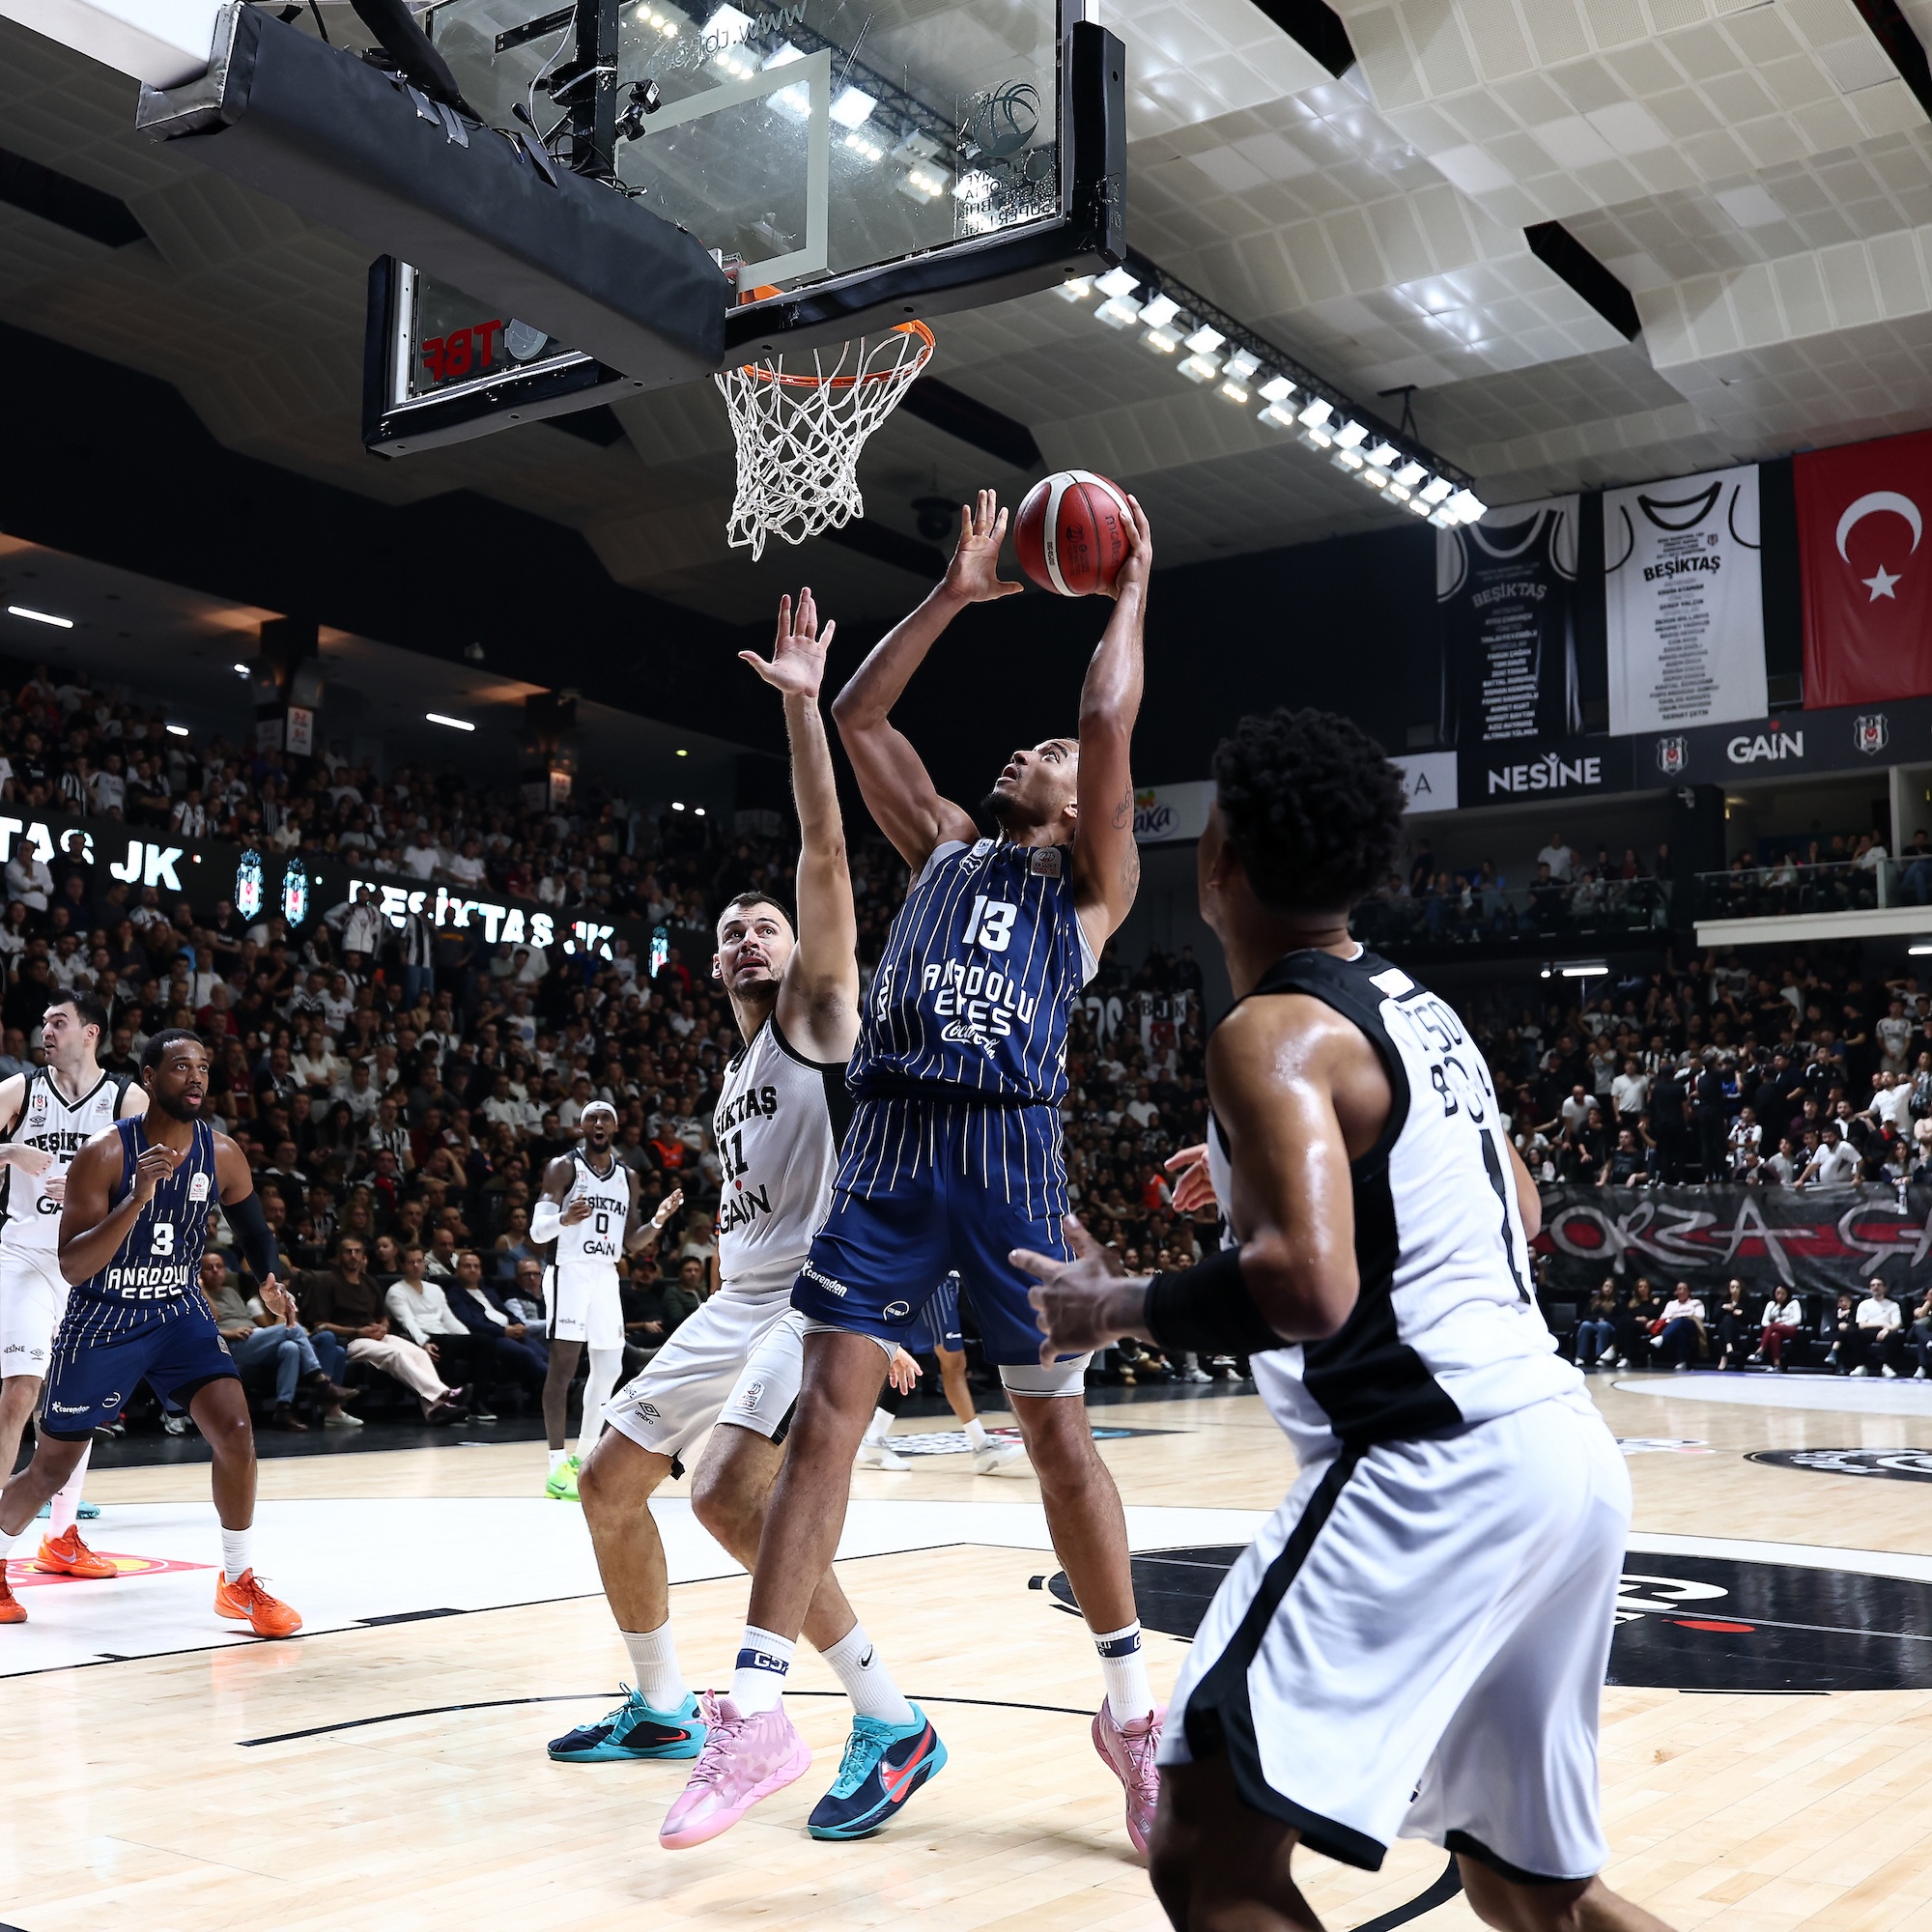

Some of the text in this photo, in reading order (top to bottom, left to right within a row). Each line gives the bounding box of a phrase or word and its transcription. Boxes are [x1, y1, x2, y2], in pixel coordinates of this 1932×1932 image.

[1643, 555, 1721, 582] BEŞİKTAŞ
[1472, 582, 1548, 609] BEŞİKTAŞ
[110, 840, 185, 892] JK
[961, 895, 1018, 952] 13
[923, 957, 1035, 1024] ANADOLU
[595, 1212, 609, 1235] 0
[151, 1223, 174, 1256] 3
[107, 1265, 188, 1291] ANADOLU
[807, 1269, 848, 1298] corendon
[634, 1407, 654, 1426] umbro
